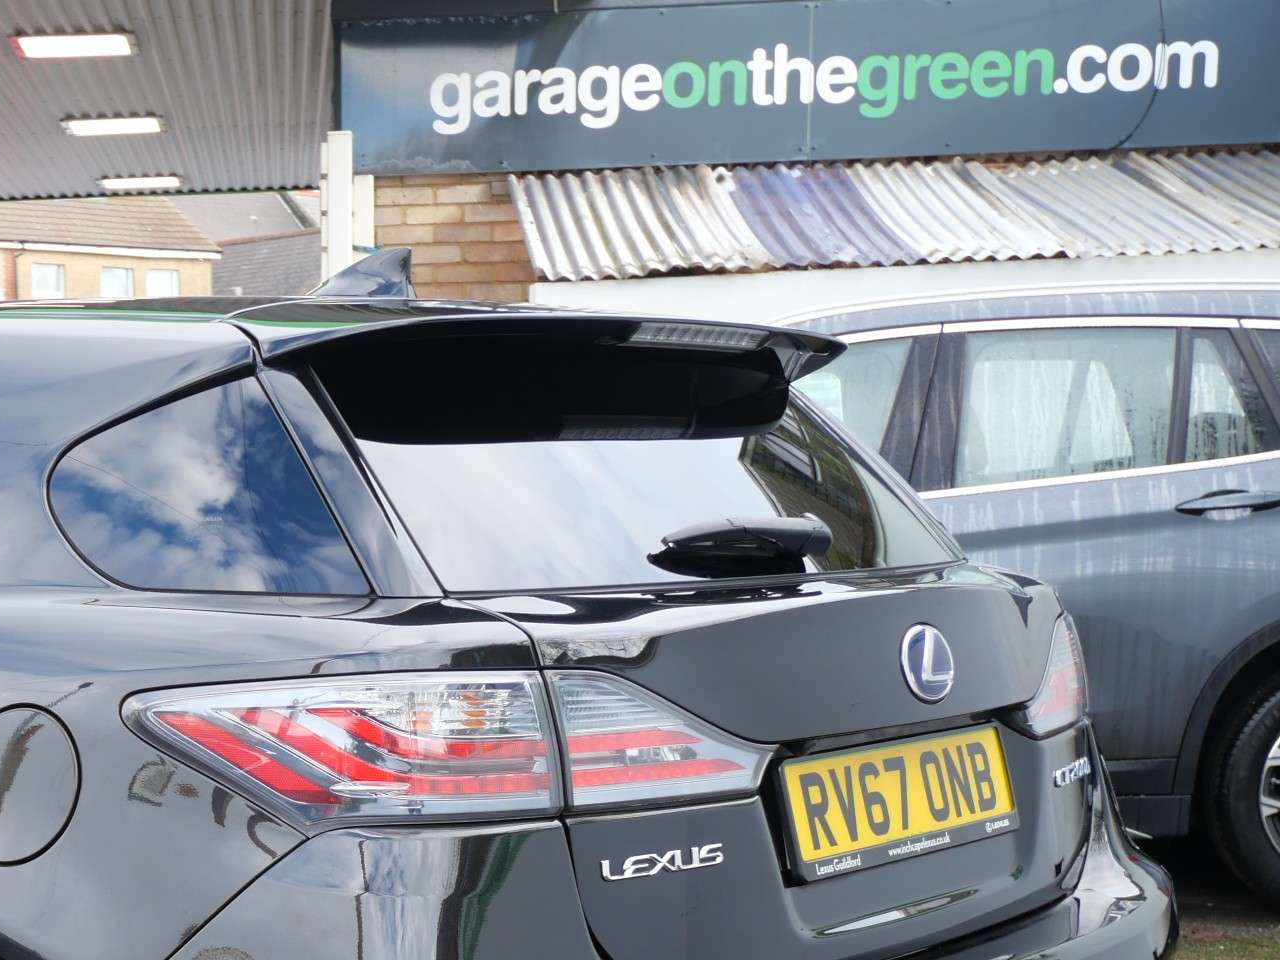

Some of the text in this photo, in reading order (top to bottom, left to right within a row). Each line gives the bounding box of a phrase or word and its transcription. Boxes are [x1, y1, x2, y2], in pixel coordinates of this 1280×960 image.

[429, 39, 1219, 135] garageonthegreen.com
[798, 741, 997, 851] RV67 ONB
[600, 843, 724, 881] LEXUS
[815, 863, 834, 876] Lexus
